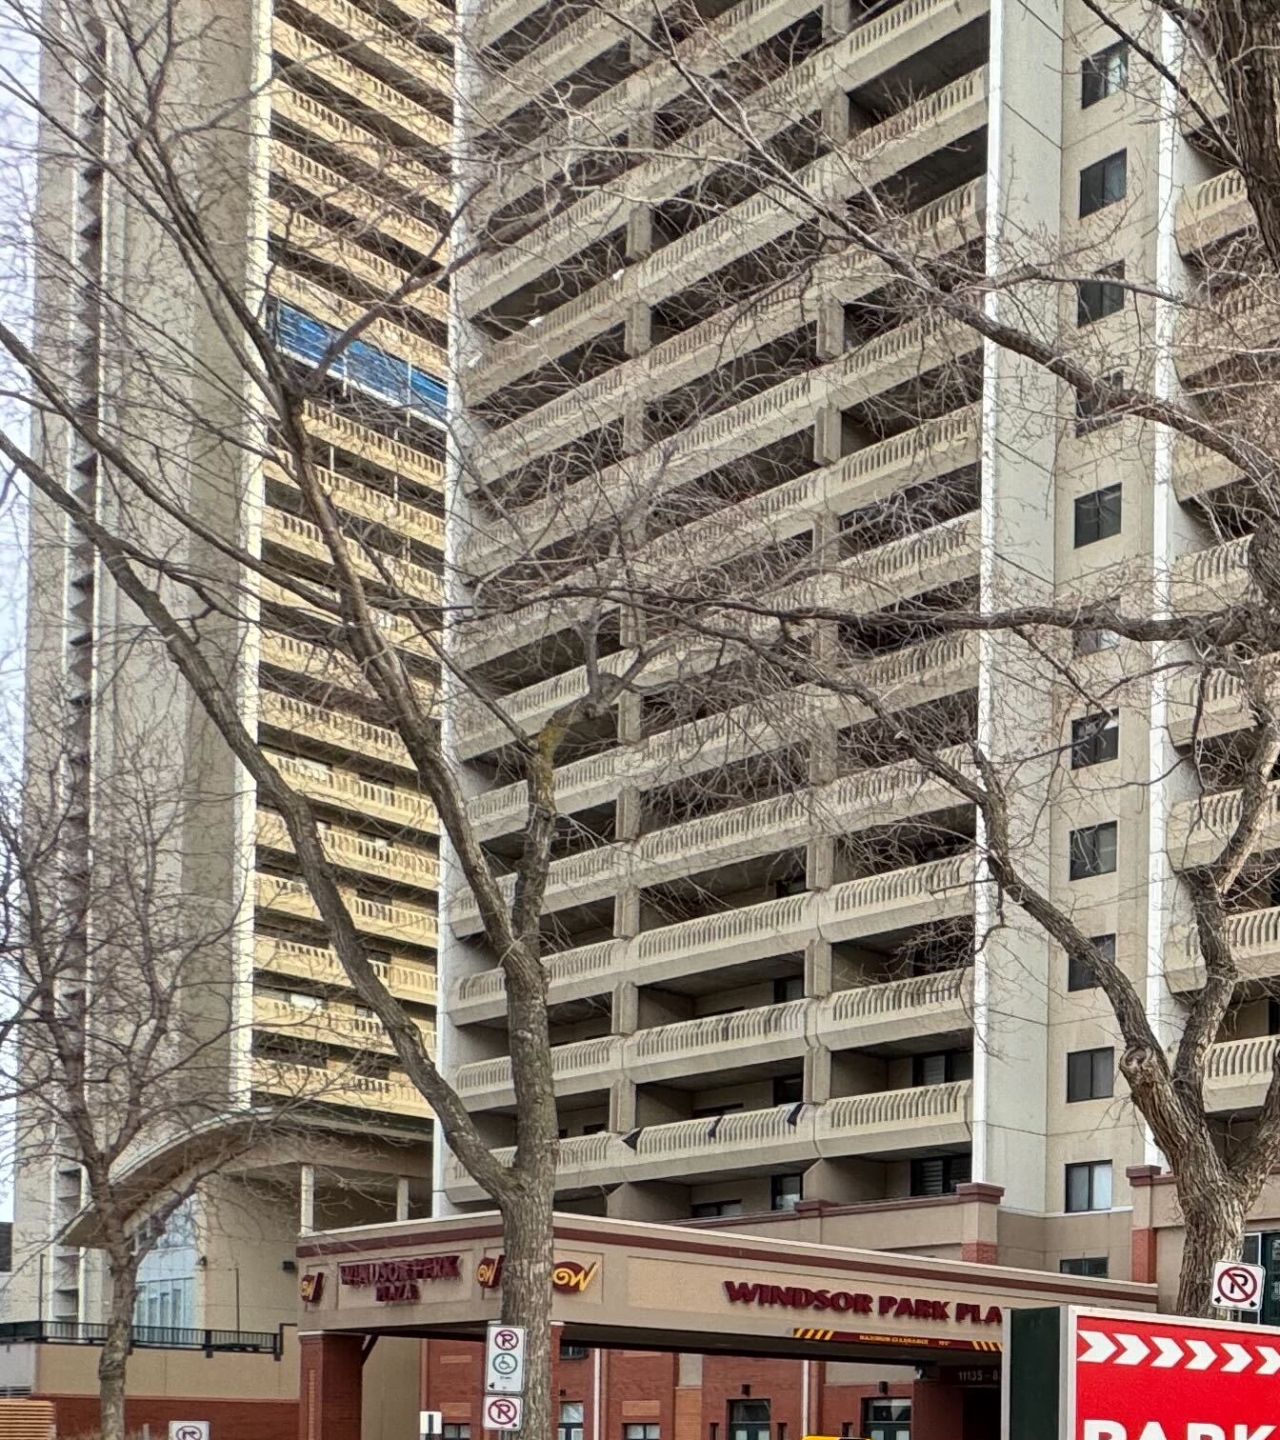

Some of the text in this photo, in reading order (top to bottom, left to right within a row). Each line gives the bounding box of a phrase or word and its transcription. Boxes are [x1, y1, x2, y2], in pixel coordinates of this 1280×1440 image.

[724, 1281, 874, 1314] WINDSOR
[878, 1295, 950, 1321] PARK
[958, 1370, 983, 1381] 11135
